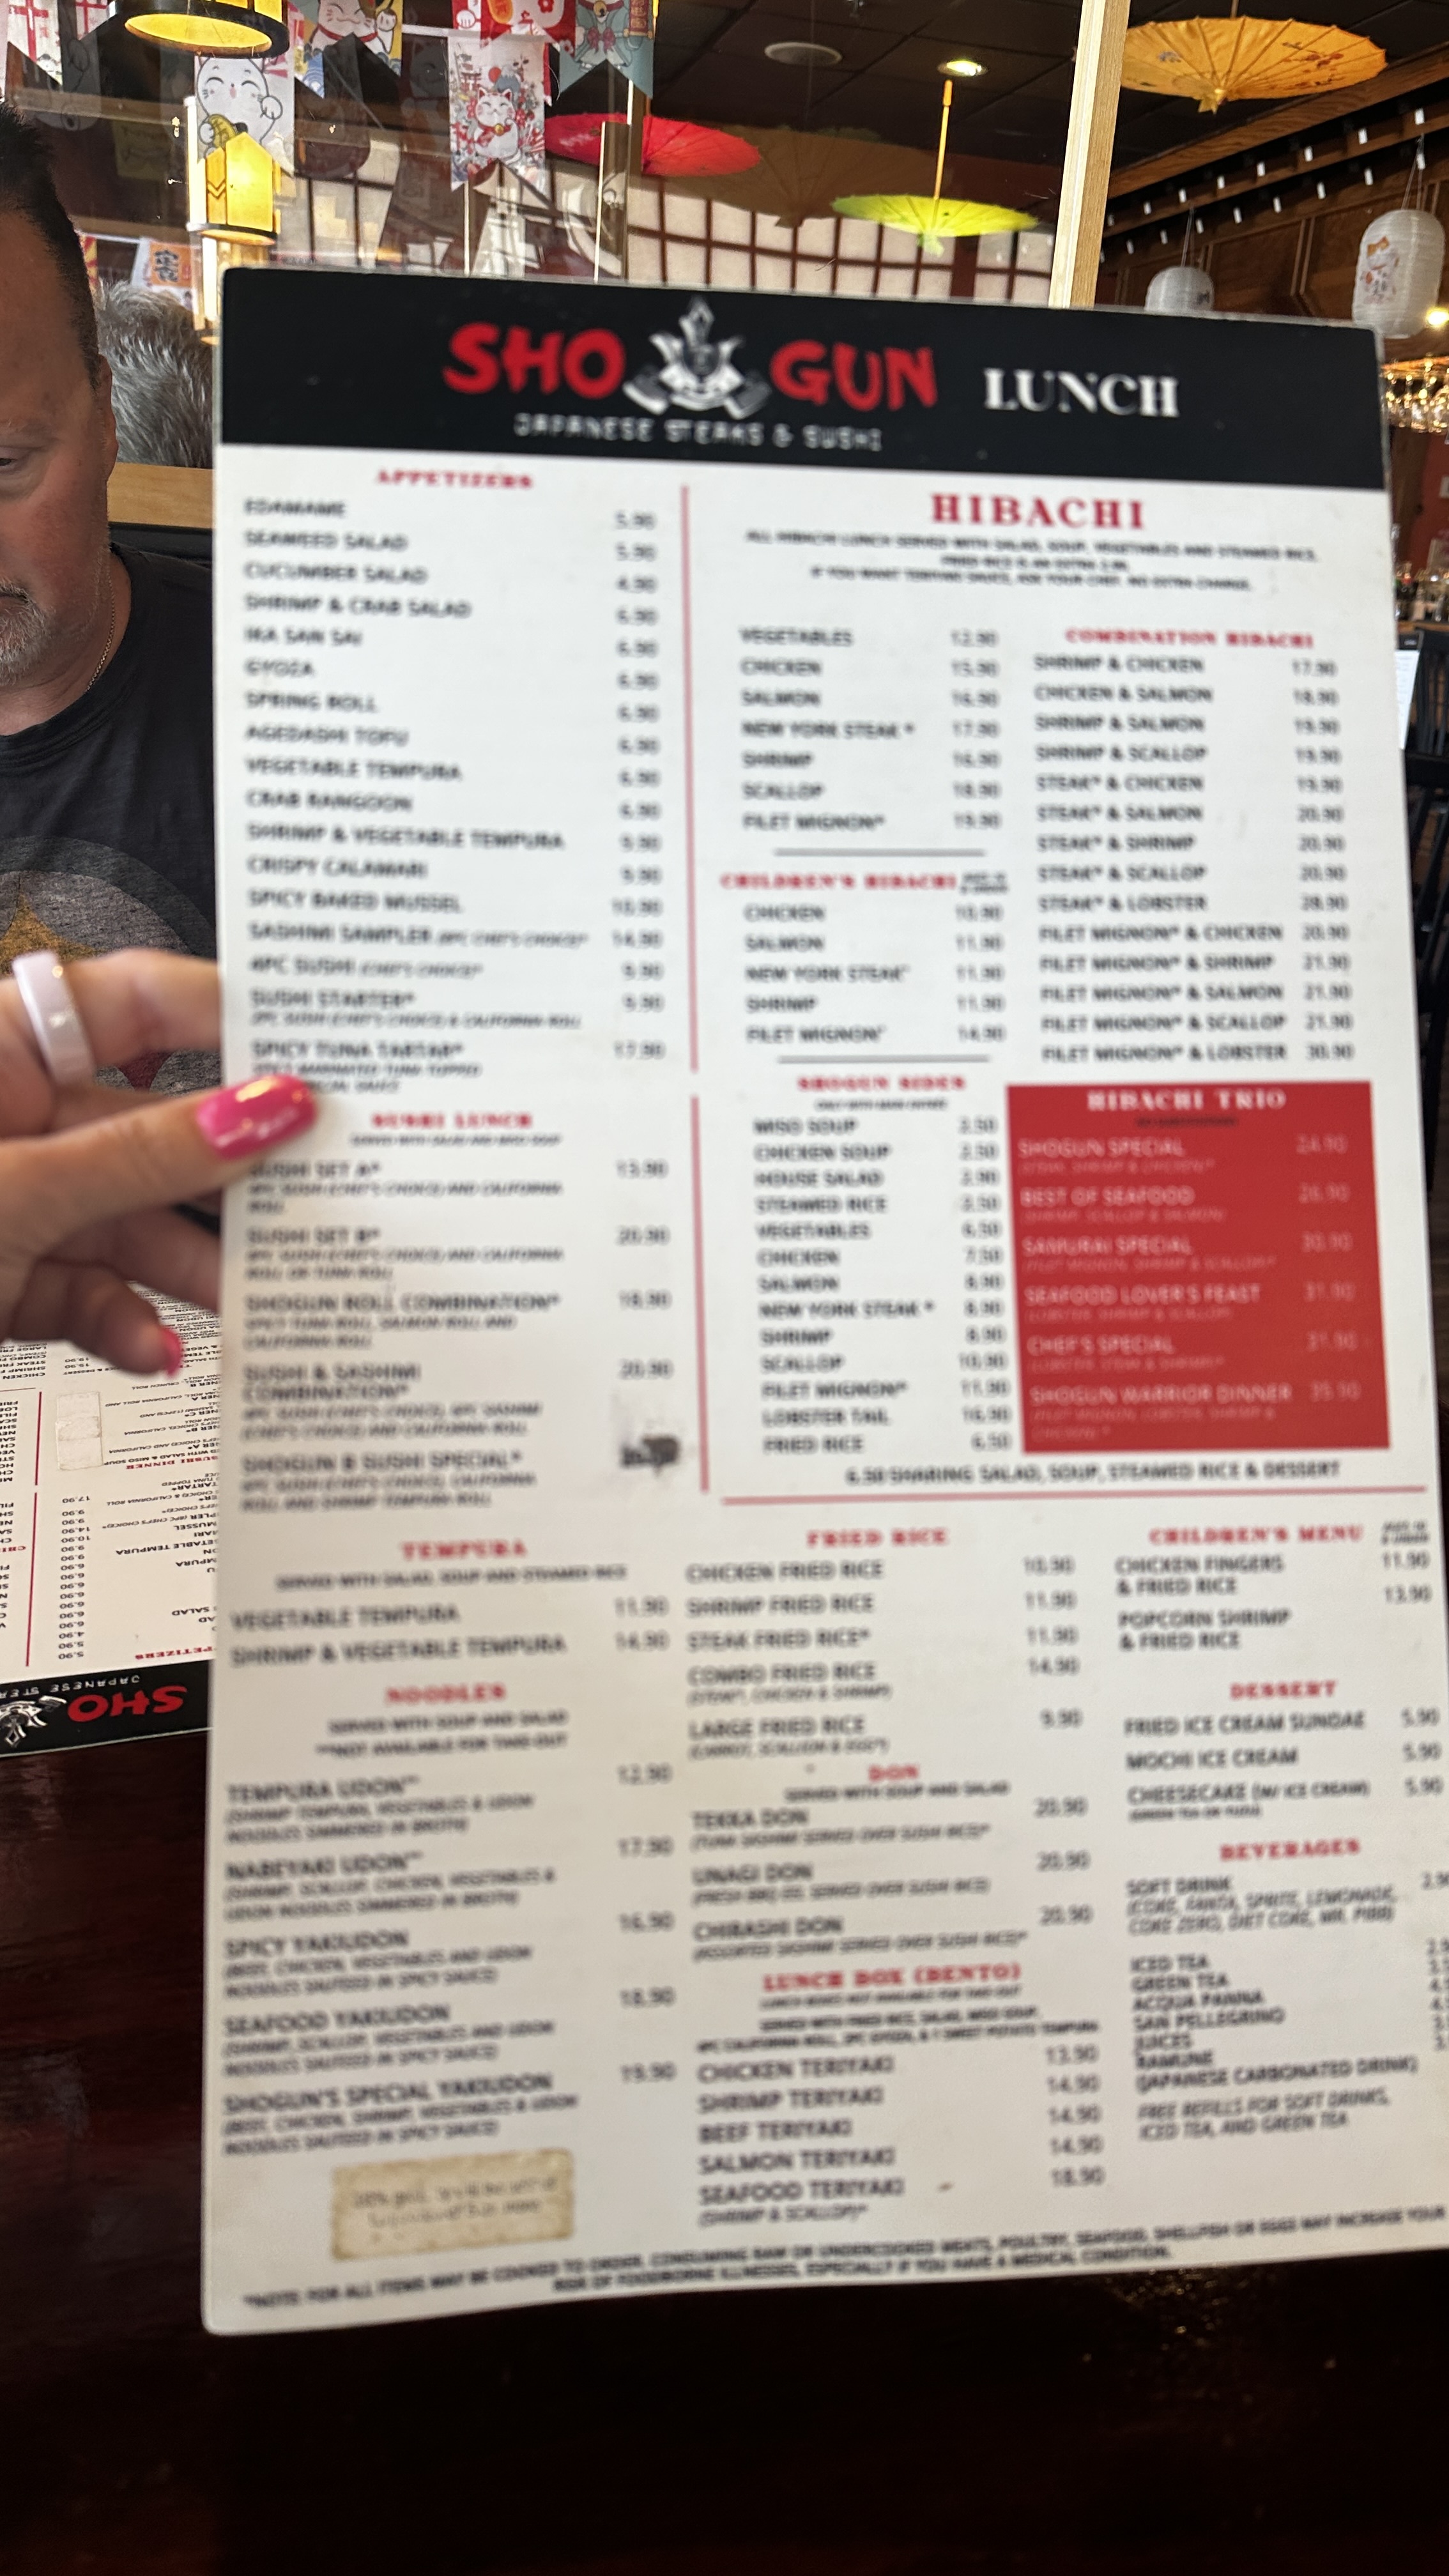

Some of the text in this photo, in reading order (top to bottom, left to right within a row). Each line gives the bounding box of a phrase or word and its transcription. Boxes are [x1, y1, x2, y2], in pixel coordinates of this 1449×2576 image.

[441, 322, 938, 411] SHO GUN
[983, 367, 1181, 418] LUNCH
[516, 413, 652, 441] JAPANESE
[665, 419, 763, 446] STEAKS
[803, 425, 882, 451] SUSHI
[378, 470, 533, 489] APPETIZERS
[930, 493, 1146, 530] HIBACHI
[244, 562, 427, 585] CUCUMBER SALAD
[1065, 629, 1314, 648] COMBINATION HIBACHI
[1034, 686, 1114, 701] CHICKEN
[1137, 687, 1213, 703] SALMON
[1035, 715, 1105, 731] SHRIMP
[1128, 716, 1206, 732] SALMON
[1087, 1089, 1286, 1110] HIBACHI TRIO
[174, 1521, 217, 1530] MUSSEL
[1149, 1525, 1362, 1545] CHILDREN'S MENU
[806, 1528, 947, 1548] FRIED RICE
[116, 1545, 169, 1555] TEMPURA
[401, 1540, 526, 1561] TEMPURA
[171, 1607, 209, 1616] SALAD
[50, 1675, 139, 1692] JAPANESE
[385, 1683, 507, 1705] NOODLES
[1230, 1680, 1336, 1700] DESSERT
[67, 1685, 188, 1723] SHO
[1219, 1838, 1361, 1862] BEVERAGES
[696, 2055, 894, 2084] CHICKEN TERIYAKI
[698, 2086, 884, 2114] SHRIMP TERIYAKI
[698, 2118, 853, 2145] BEEF TERIYAKI
[699, 2147, 896, 2175] SALMON TERIYAKI
[699, 2177, 905, 2206] SEAFOOD TERIYAKI
